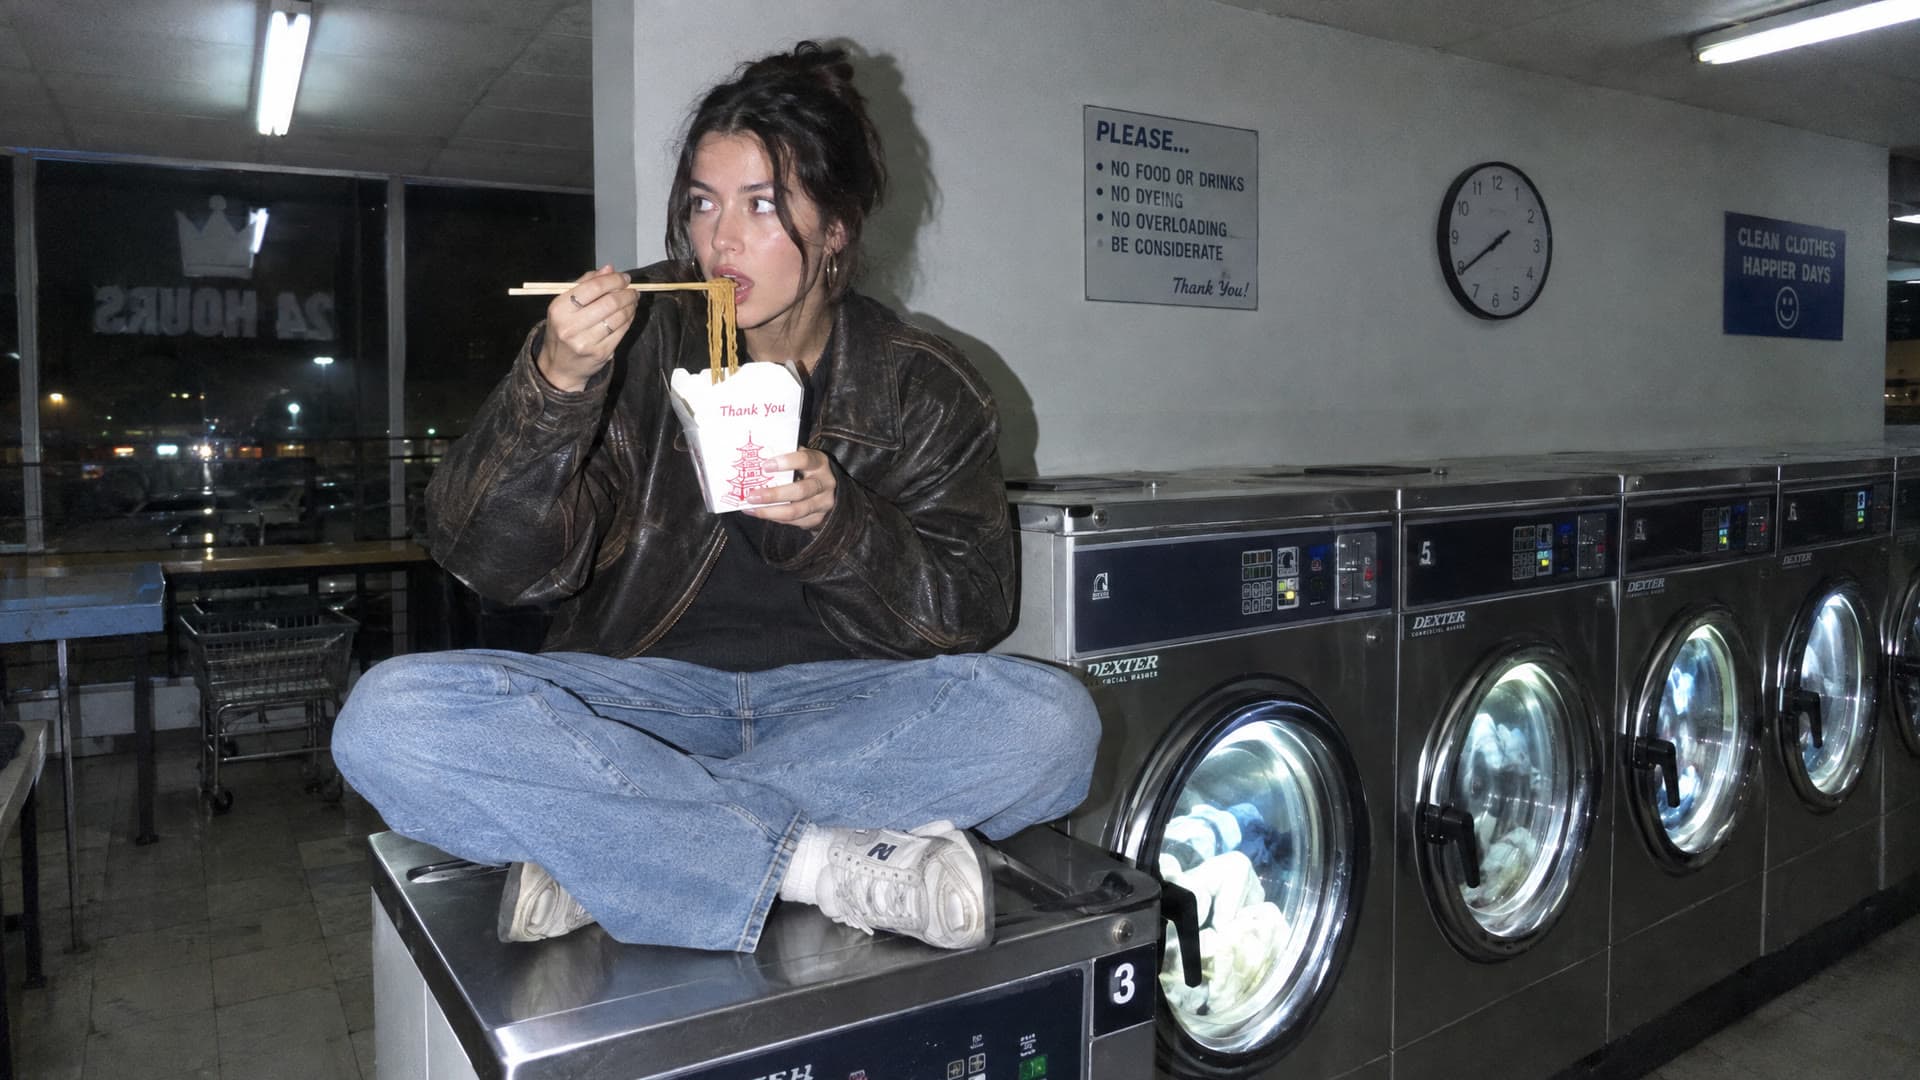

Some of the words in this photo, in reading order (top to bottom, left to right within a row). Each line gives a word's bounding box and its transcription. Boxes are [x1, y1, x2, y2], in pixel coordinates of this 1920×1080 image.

[1096, 120, 1189, 154] PLEASE...
[1111, 160, 1129, 178] NO
[1136, 163, 1170, 182] FOOD
[1176, 169, 1193, 185] OR
[1199, 172, 1245, 192] DRINKS
[1492, 175, 1503, 191] 12
[1111, 185, 1129, 202] NO
[1136, 188, 1183, 208] DYEING
[1472, 181, 1482, 196] 11
[1514, 187, 1519, 201] 1
[1458, 201, 1469, 216] 10
[1527, 209, 1535, 224] 2
[1111, 211, 1129, 228] NO
[1136, 213, 1227, 237] OVERLOADING
[1451, 230, 1459, 245] 9
[1738, 227, 1779, 250] CLEAN
[1785, 235, 1836, 259] CLOTHES
[1111, 236, 1128, 253] BE
[1135, 238, 1224, 261] CONSIDERATE
[1533, 239, 1540, 254] 3
[1457, 260, 1465, 276] 8
[1526, 267, 1533, 280] 4
[1743, 255, 1796, 280] HAPPIER
[1802, 264, 1831, 284] DAYS
[1173, 276, 1214, 295] Thank
[1218, 279, 1249, 298] You!
[1472, 283, 1480, 298] 7
[1512, 286, 1520, 301] 5
[1492, 293, 1499, 308] 6
[720, 403, 758, 417] Thank
[764, 403, 786, 417] You
[1413, 610, 1466, 629] DEXTER
[1087, 655, 1158, 677] DEXTER
[1111, 962, 1136, 1006] 3
